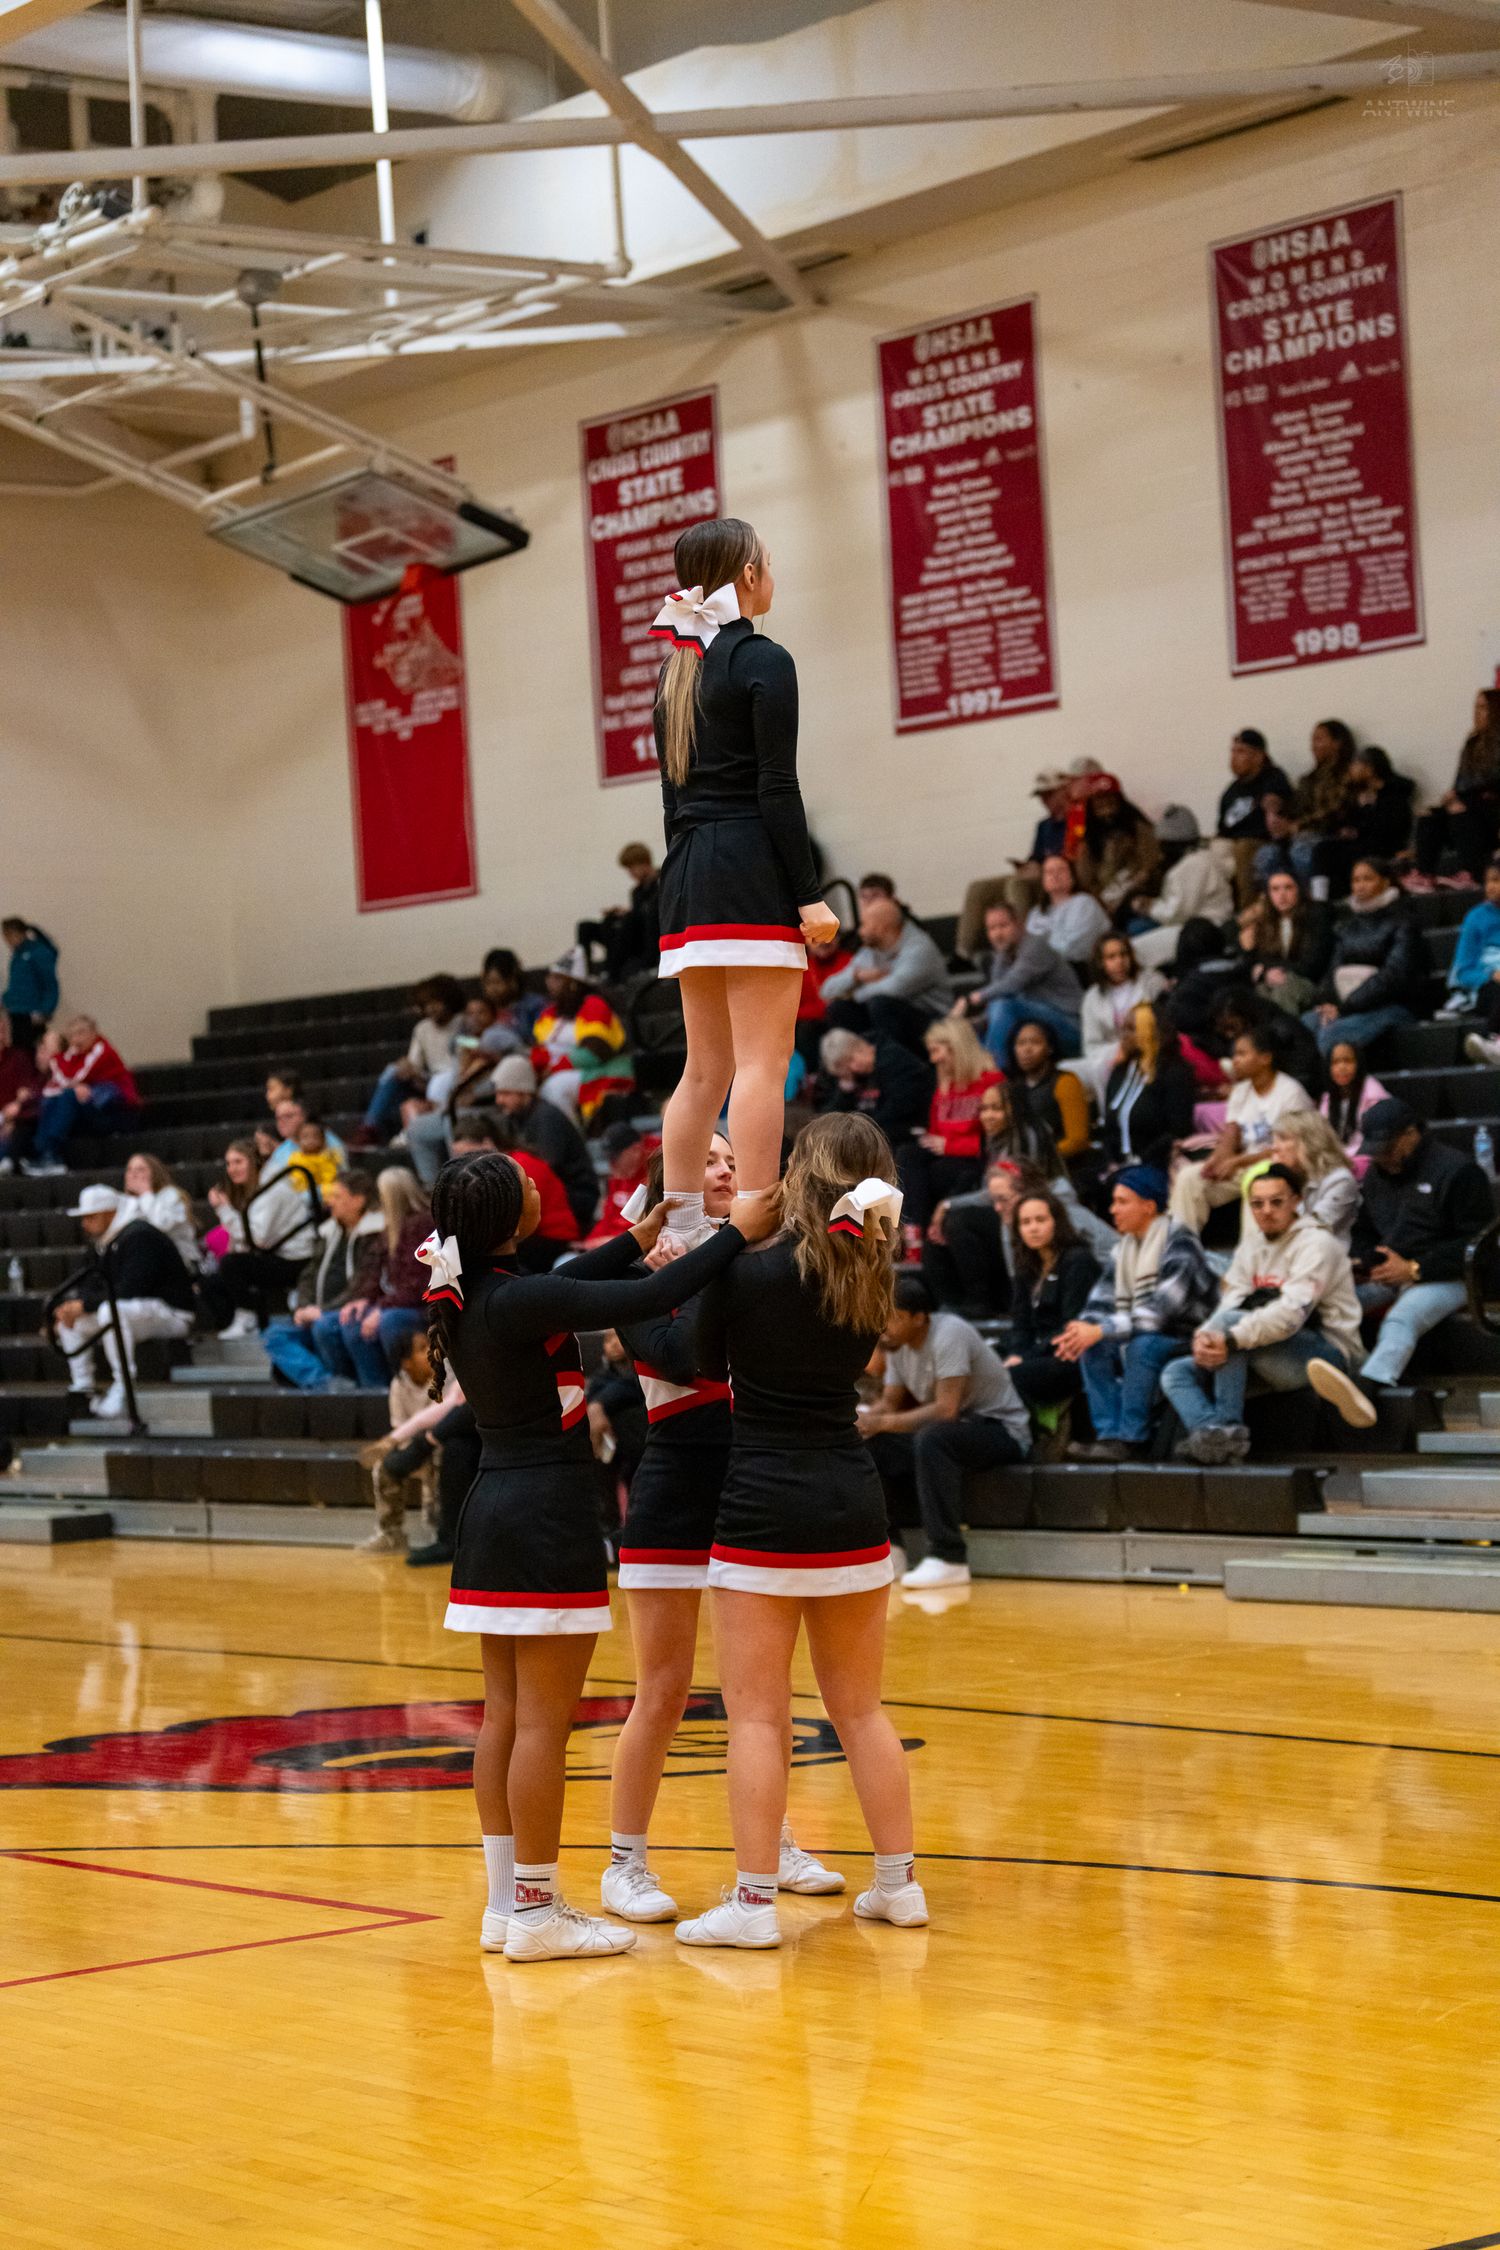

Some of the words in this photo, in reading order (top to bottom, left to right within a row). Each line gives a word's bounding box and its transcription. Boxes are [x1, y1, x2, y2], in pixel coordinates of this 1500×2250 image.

[1227, 291, 1289, 319] CROSS
[1298, 266, 1387, 301] COUNTRY
[1263, 301, 1353, 339] STATE
[1226, 315, 1395, 373] CHAMPIONS
[892, 383, 944, 407] CROSS
[947, 361, 1023, 393] COUNTRY
[923, 391, 995, 426] STATE
[891, 407, 1031, 458] CHAMPIONS
[619, 468, 684, 504] STATE
[591, 489, 715, 540] CHAMPIONS
[1294, 624, 1360, 654] 1998
[948, 688, 1001, 716] 1997
